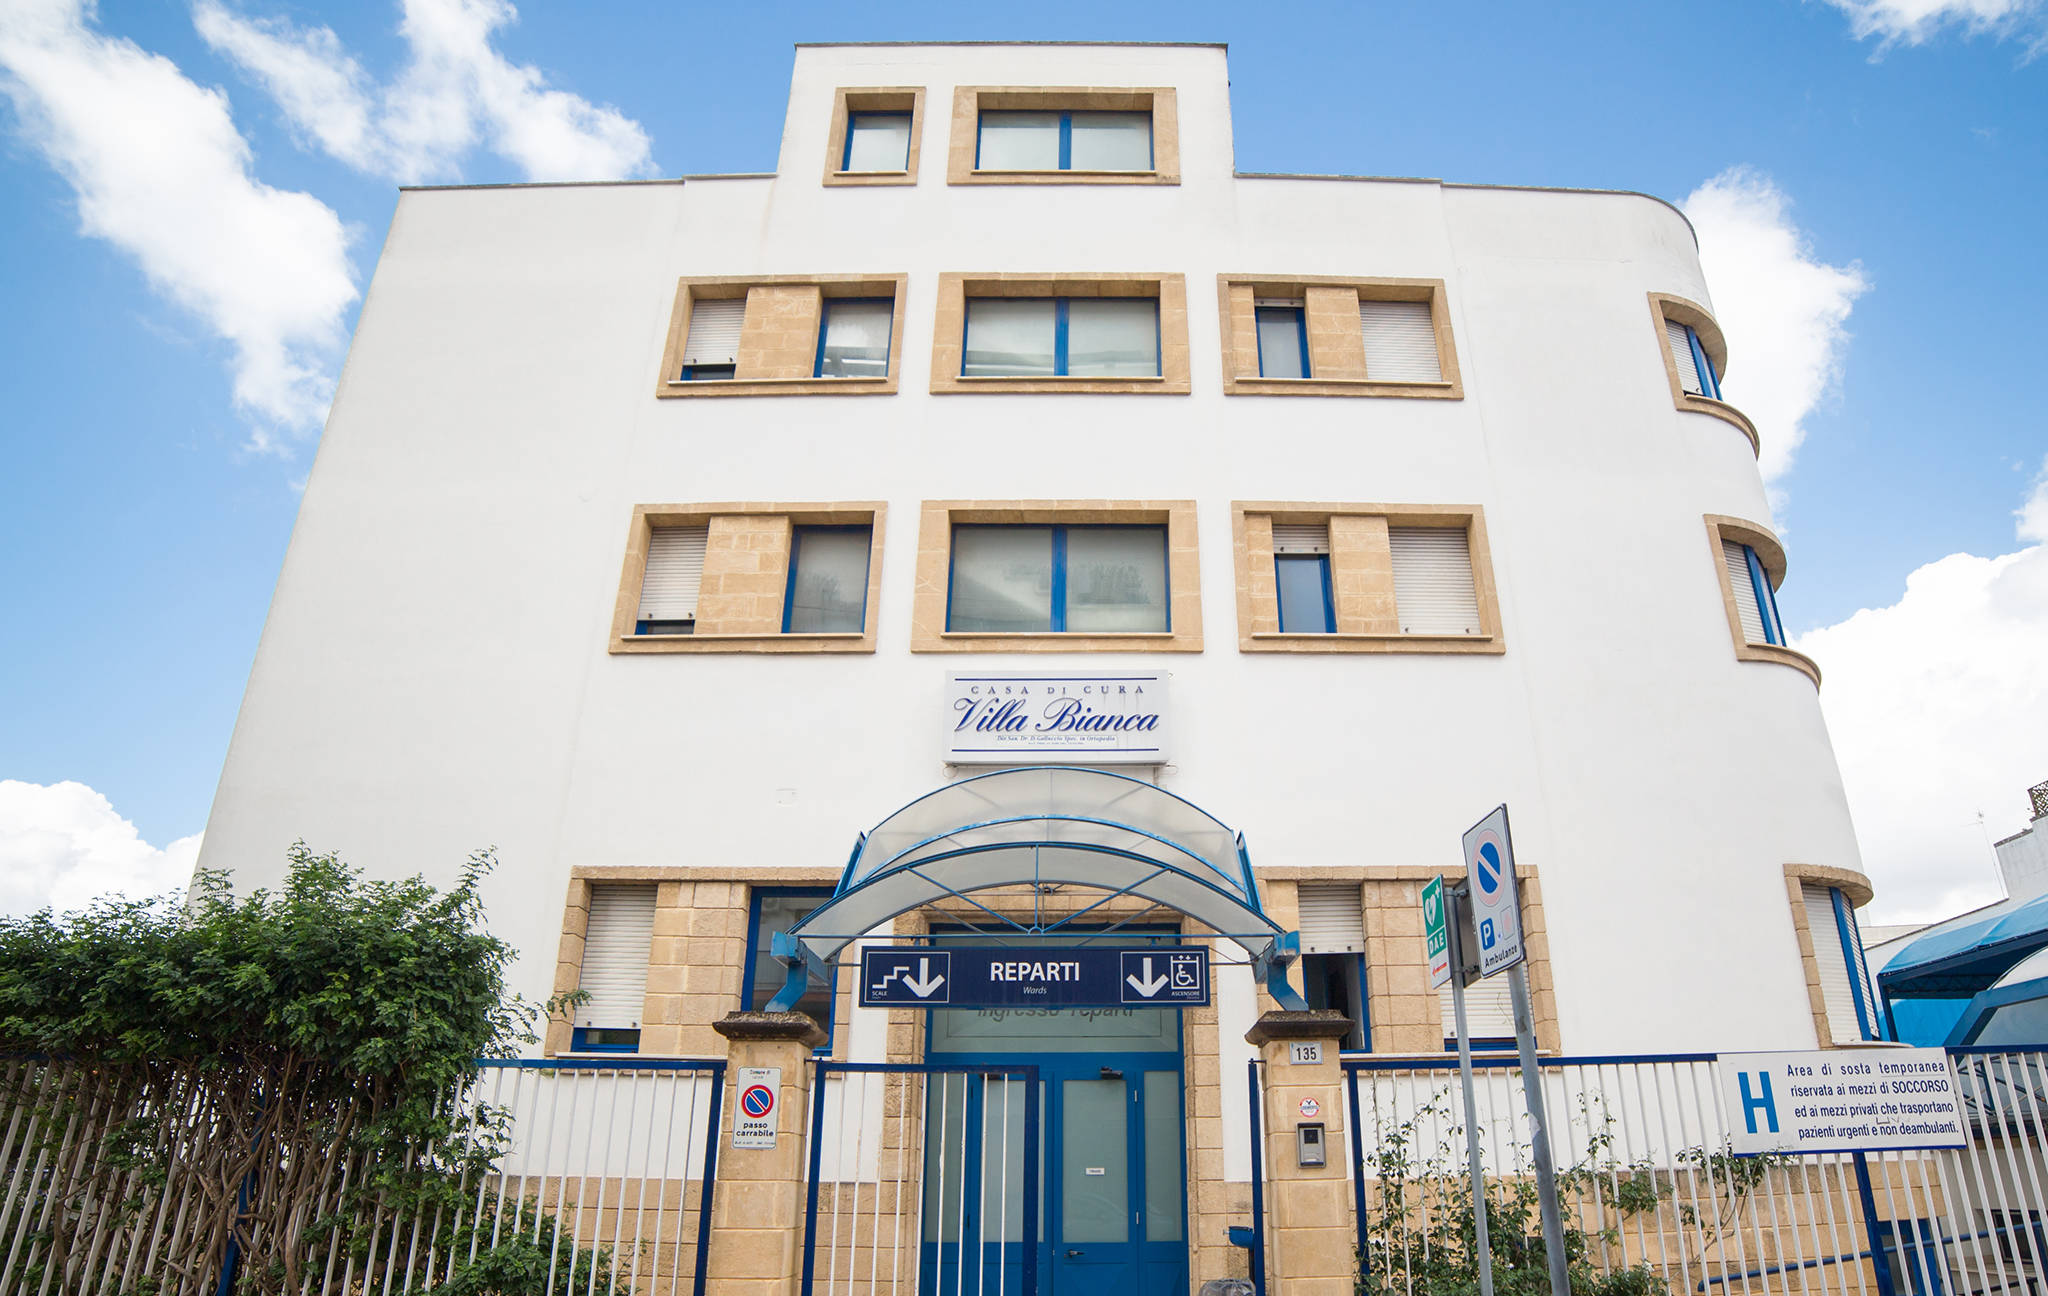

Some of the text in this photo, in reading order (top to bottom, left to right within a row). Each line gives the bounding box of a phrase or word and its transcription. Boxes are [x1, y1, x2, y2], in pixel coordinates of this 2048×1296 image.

[970, 685, 1144, 695] CASA DI CURA
[953, 697, 1160, 733] Villa Bianca
[1428, 933, 1445, 955] DAE
[1483, 923, 1491, 946] P
[1485, 944, 1518, 969] Ambulanze
[990, 961, 1080, 982] REPARTI
[1023, 985, 1047, 995] Wards
[1296, 1047, 1317, 1061] 135
[1787, 1061, 1945, 1077] Area di sosta temporanea
[1790, 1079, 1949, 1097] riservata ai mezzi di SOCCORSO
[1737, 1071, 1780, 1134] H
[1795, 1100, 1954, 1118] ed ai mezzi privati che trasportano
[736, 1129, 774, 1137] carrabile
[1798, 1120, 1959, 1141] pazienti urgenti e non deambulanti.
